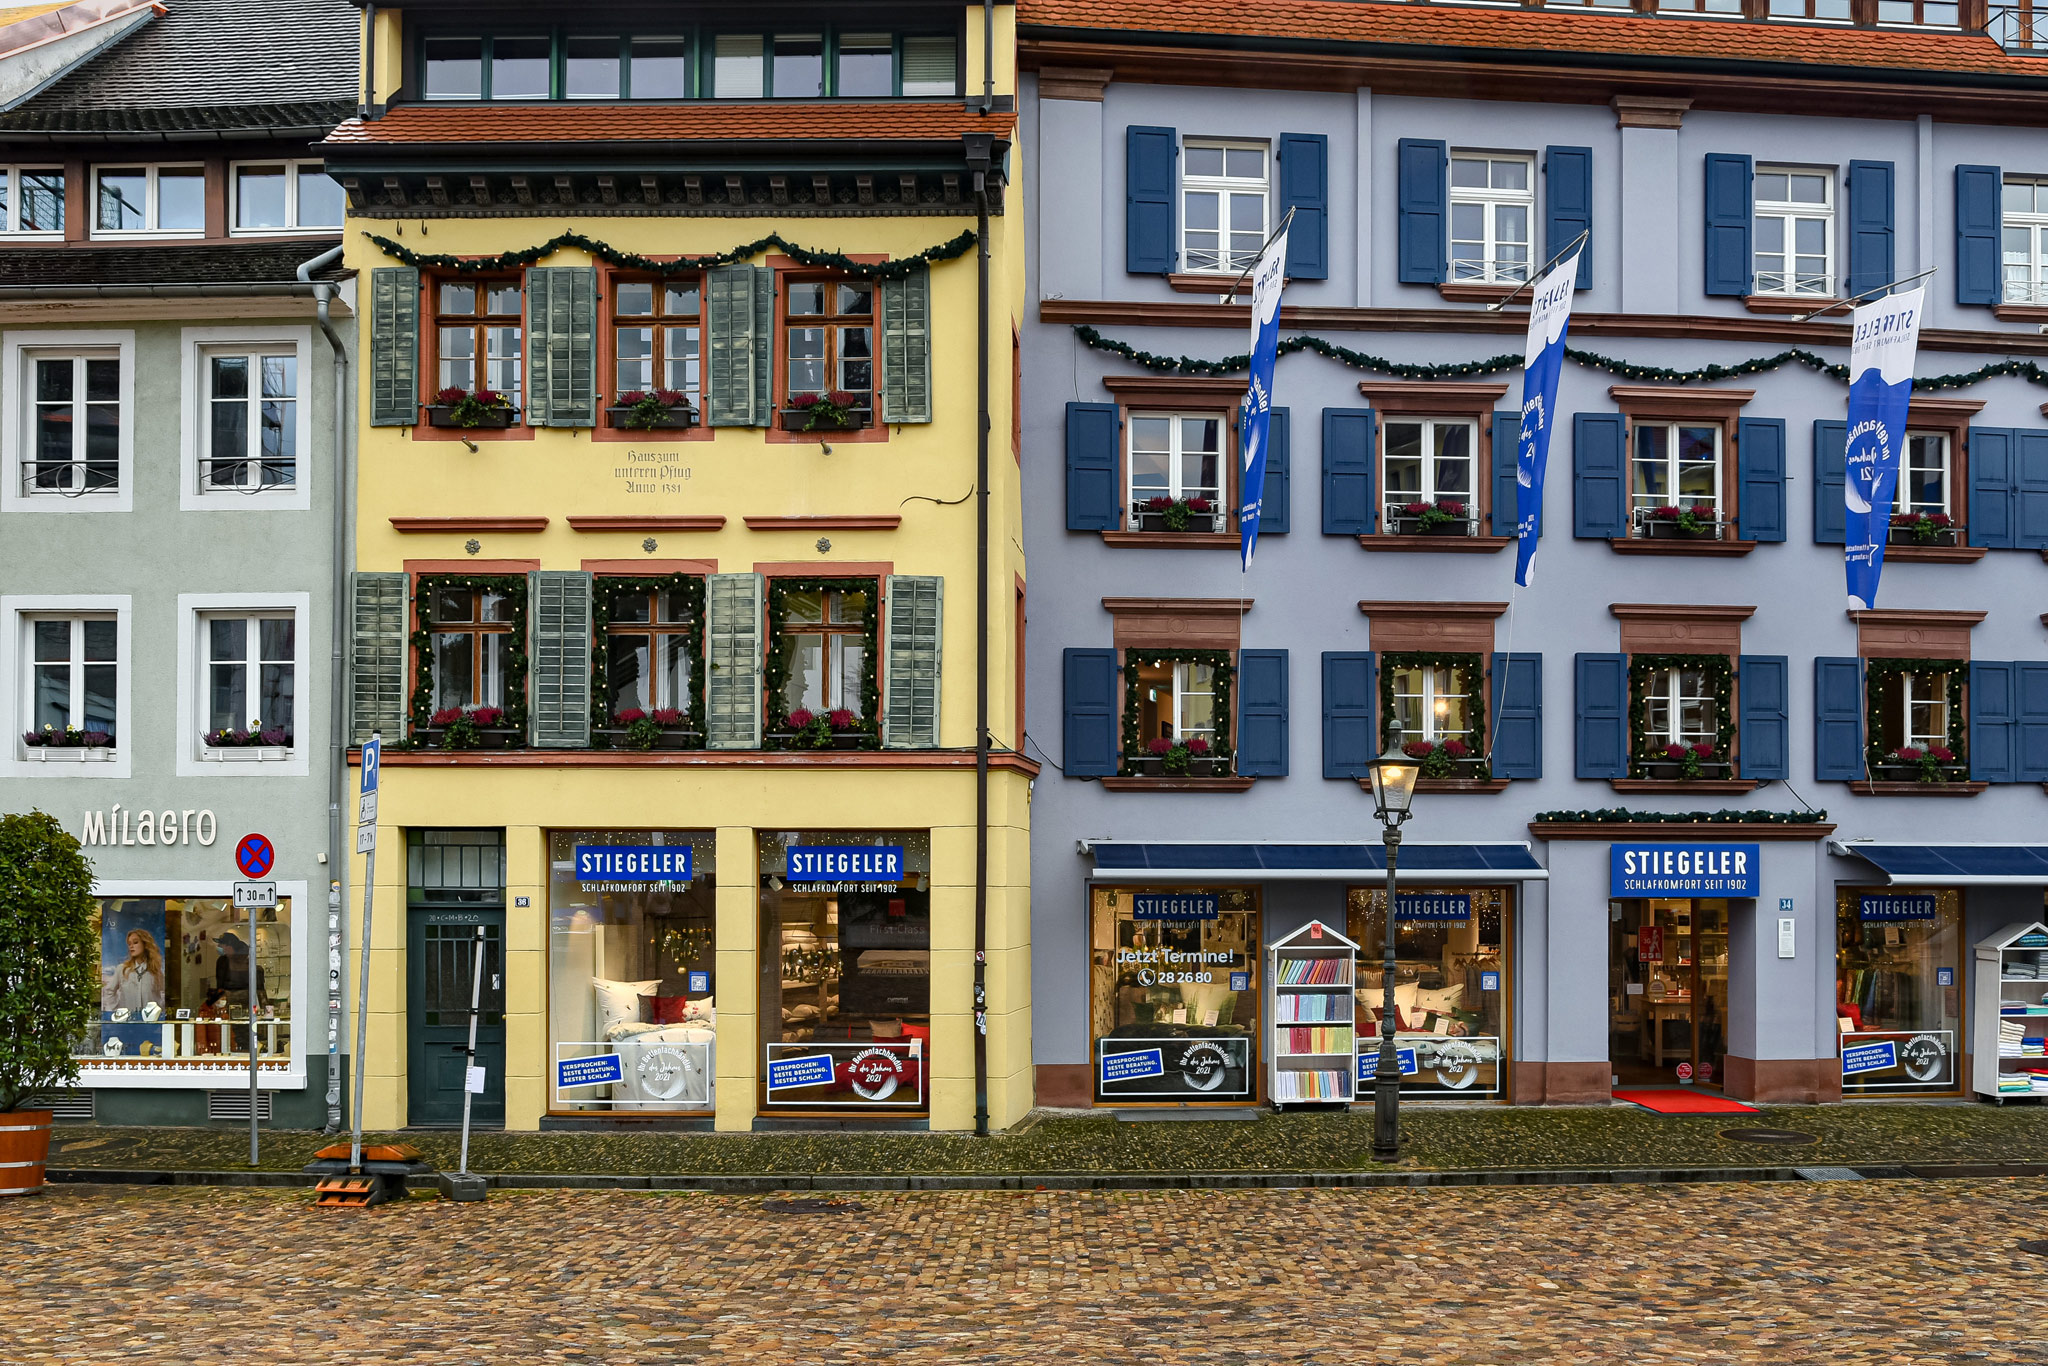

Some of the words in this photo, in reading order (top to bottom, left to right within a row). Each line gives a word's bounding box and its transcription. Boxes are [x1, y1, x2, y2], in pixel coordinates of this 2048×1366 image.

[614, 466, 657, 478] unteren
[626, 480, 656, 493] Anno
[364, 748, 375, 787] P
[582, 853, 686, 873] STIEGELER
[792, 854, 897, 873] STIEGELER
[1624, 851, 1747, 875] STIEGELER
[582, 883, 647, 892] SCHLAFKOMFORT
[649, 883, 666, 892] SEIT
[668, 884, 686, 892] 1902
[792, 884, 858, 893] SCHLAFKOMFORT
[861, 884, 877, 893] SEIT
[879, 884, 897, 893] 1902
[1624, 880, 1702, 890] SCHLAFKOMFORT
[1704, 880, 1723, 890] SEIT
[1727, 880, 1747, 890] 1902
[247, 890, 257, 901] 30
[259, 893, 266, 901] m
[1137, 900, 1214, 914] STIEGELER
[1394, 900, 1466, 914] STIEGELER
[1781, 899, 1791, 909] 34
[1863, 901, 1931, 914] STIEGELER
[1116, 949, 1158, 963] Jetzt
[1161, 948, 1234, 963] Termine!
[1158, 972, 1175, 983] 28
[1177, 972, 1193, 983] 26
[1195, 972, 1212, 983] 80
[563, 1069, 581, 1077] BESTE
[1195, 1066, 1211, 1075] 2021
[563, 1075, 587, 1083] BESTER
[655, 1072, 670, 1081] 2021
[865, 1073, 882, 1082] 2021
